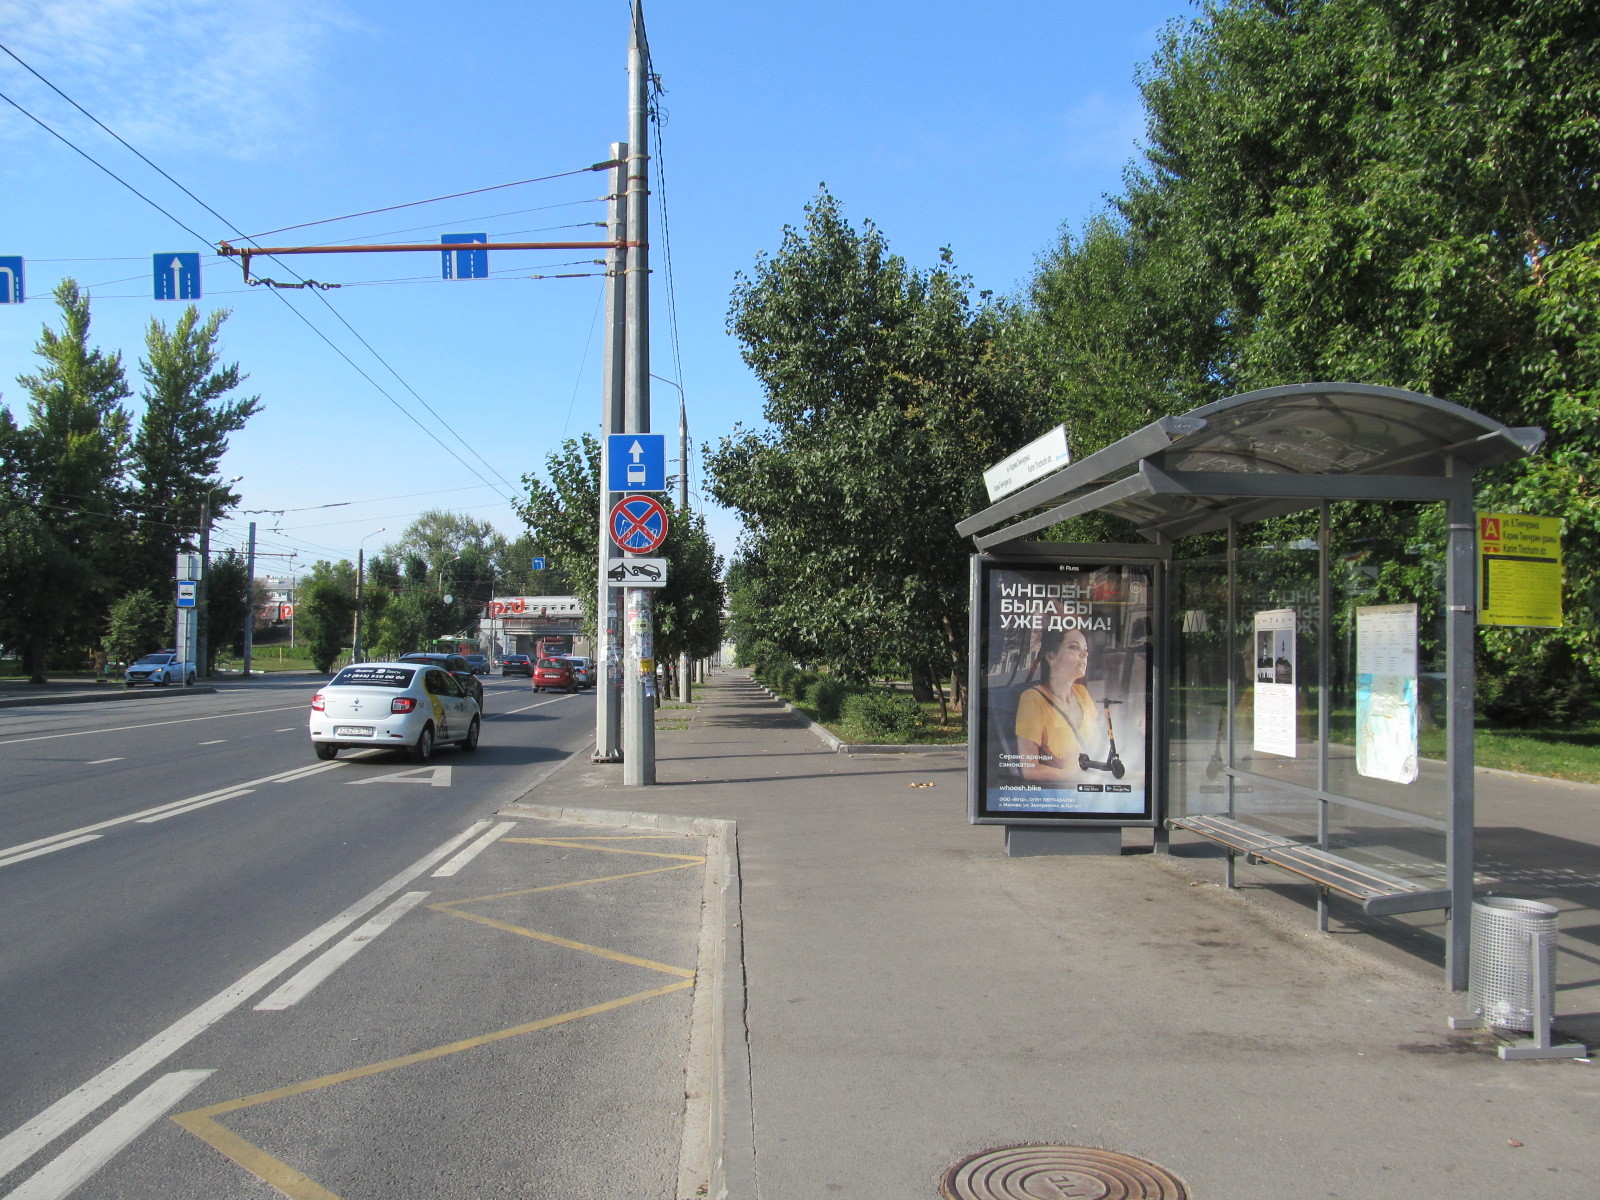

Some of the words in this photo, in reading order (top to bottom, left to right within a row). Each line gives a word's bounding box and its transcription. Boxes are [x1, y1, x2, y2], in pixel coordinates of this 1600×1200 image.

[1001, 583, 1092, 598] WHOOSH
[1001, 599, 1058, 614] БЫЛА
[1063, 600, 1093, 615] БЫ
[1000, 614, 1043, 629] УЖЕ
[1048, 615, 1112, 632] ДОМА!
[998, 753, 1025, 761] Сервис
[999, 784, 1042, 792] whoosh.bike
